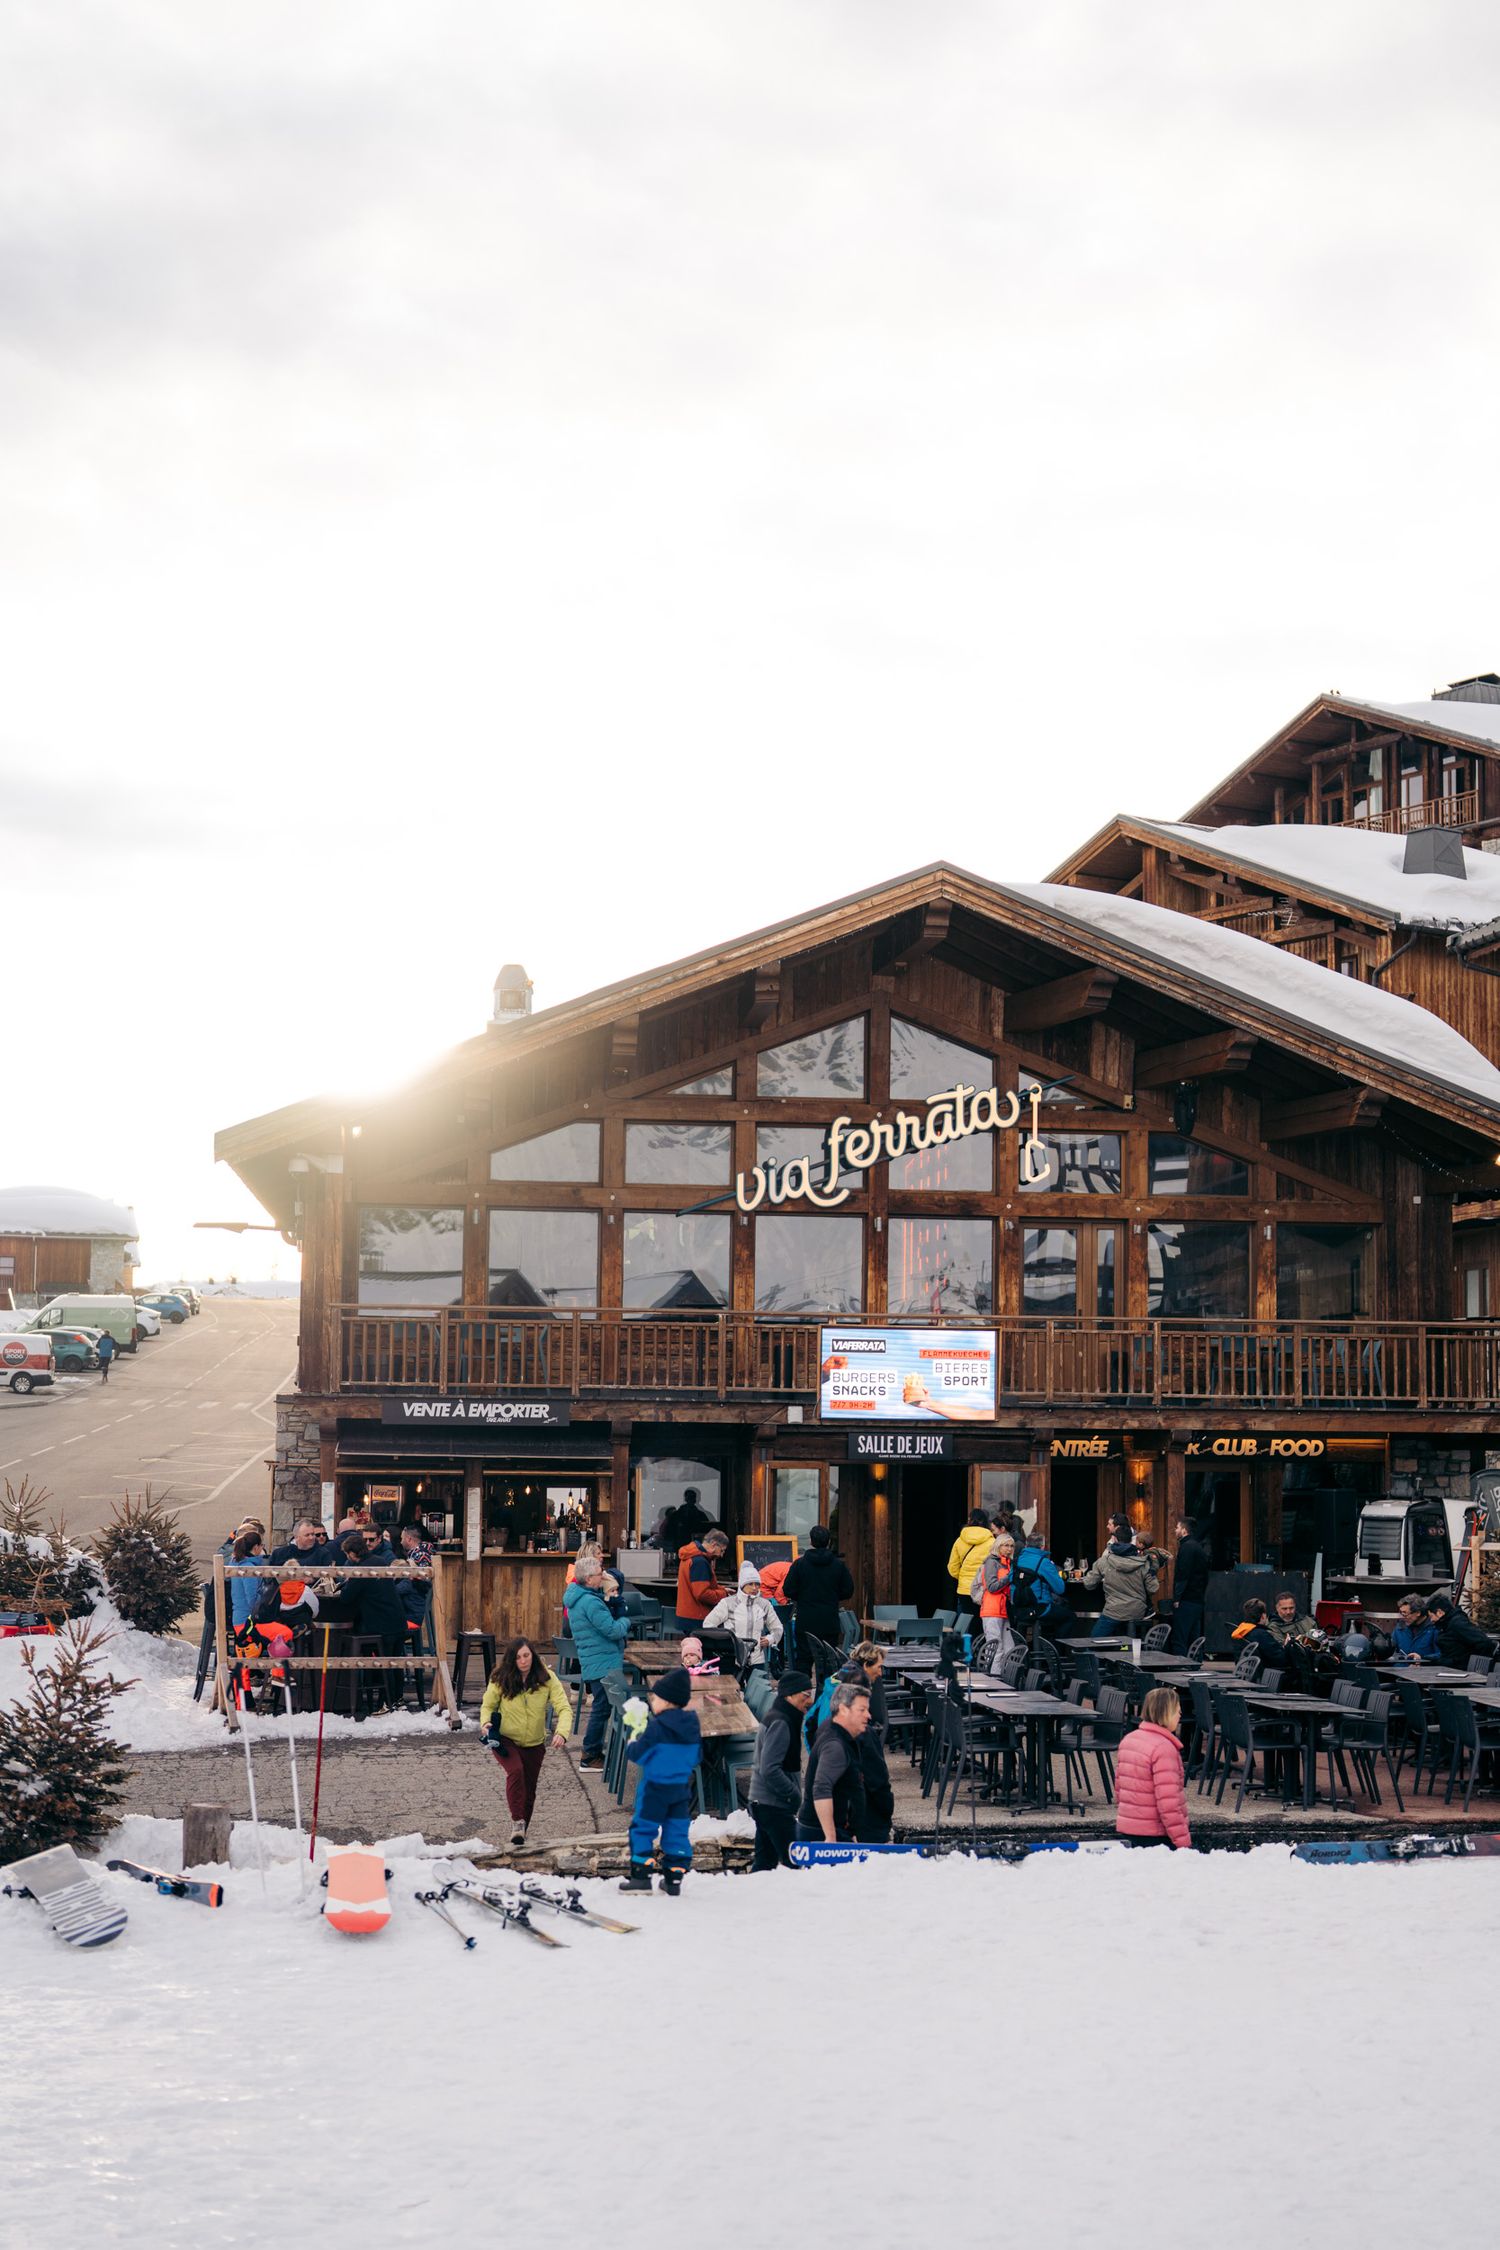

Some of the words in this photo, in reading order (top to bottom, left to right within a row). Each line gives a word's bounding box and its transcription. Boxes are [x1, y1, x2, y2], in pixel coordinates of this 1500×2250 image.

[736, 1155, 849, 1211] via
[823, 1082, 1020, 1193] ferrata
[935, 1362, 988, 1374] BIERES
[832, 1372, 896, 1384] BURGERS
[944, 1376, 988, 1387] SPORT
[832, 1385, 887, 1396] SNACKS
[402, 1402, 451, 1417] VENTE
[452, 1399, 466, 1417] À
[468, 1403, 550, 1418] EMPORTER
[857, 1435, 894, 1453] SALLE
[897, 1436, 913, 1454] DE
[915, 1436, 944, 1454] JEUX
[1212, 1438, 1258, 1456] CLUB
[1269, 1439, 1325, 1457] FOOD
